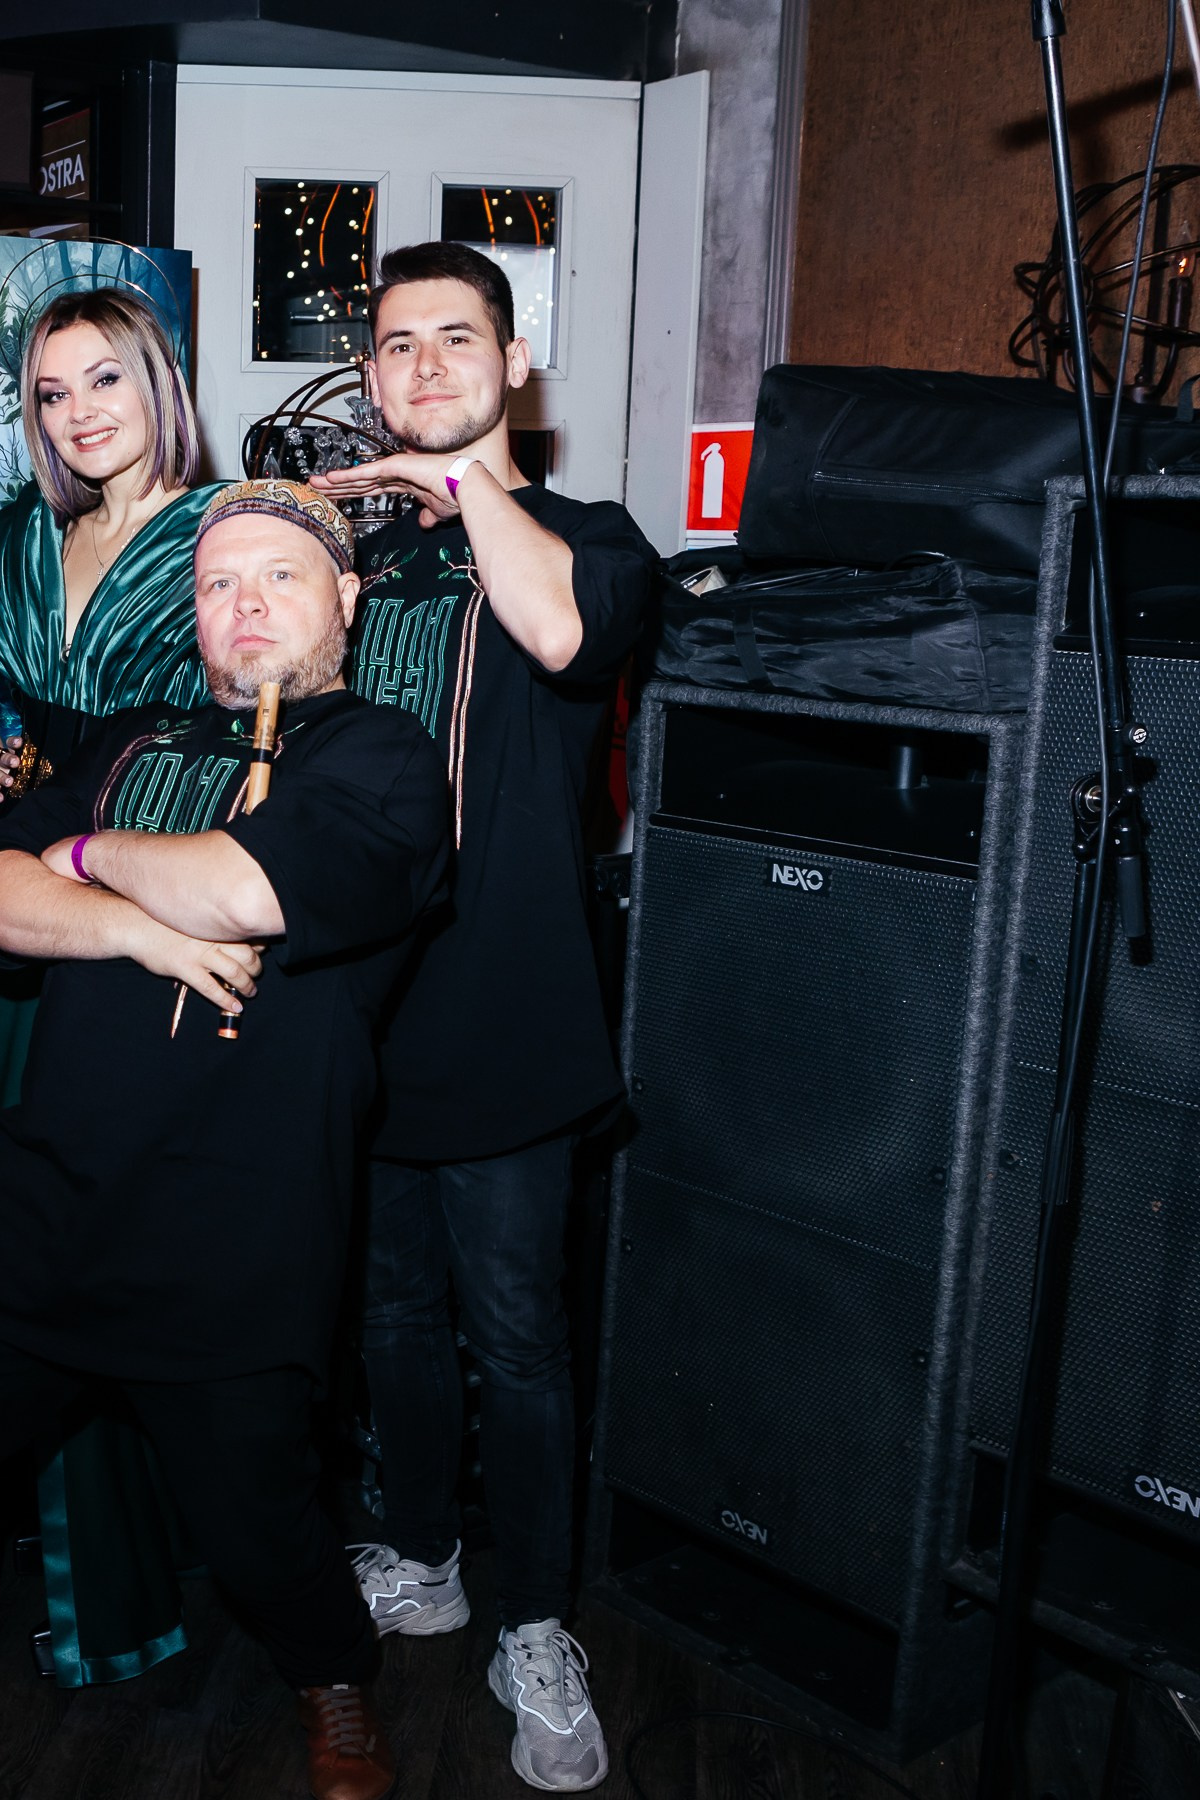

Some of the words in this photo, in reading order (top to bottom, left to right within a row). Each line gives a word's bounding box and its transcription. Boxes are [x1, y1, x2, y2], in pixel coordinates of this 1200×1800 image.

[772, 863, 824, 891] NEXO
[1134, 1474, 1200, 1518] NEXO
[721, 1509, 768, 1545] NEXO
